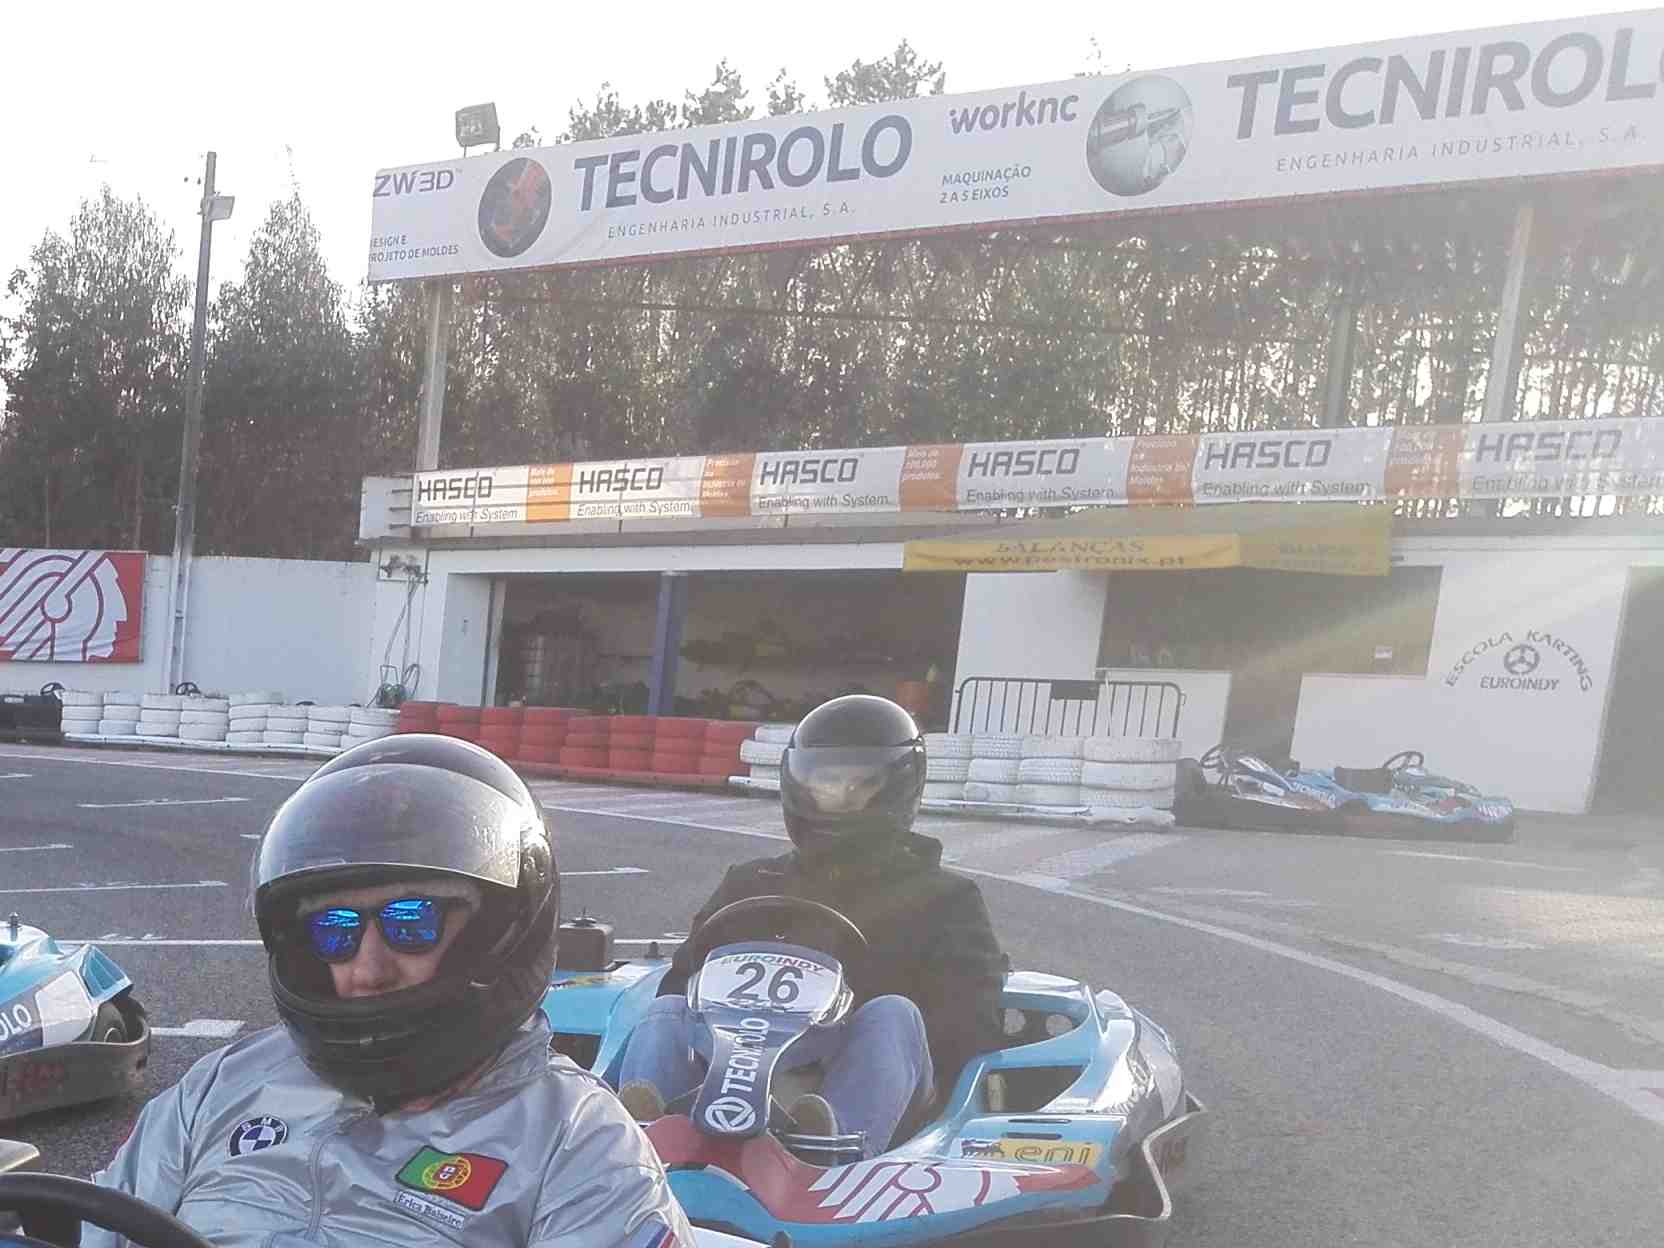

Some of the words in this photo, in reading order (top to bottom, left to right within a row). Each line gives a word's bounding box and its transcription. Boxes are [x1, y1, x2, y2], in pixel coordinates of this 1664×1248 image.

[1227, 27, 1664, 140] TECNIROL
[949, 91, 1079, 134] worknc
[574, 115, 913, 211] TECNIROLO
[1277, 145, 1419, 173] ENGENHARIA
[373, 170, 454, 197] ZW3D
[942, 164, 1032, 187] MAQUINAÇÃO
[950, 192, 959, 203] A
[972, 186, 1009, 201] EIXOS
[608, 217, 706, 239] ENGENHARIA
[422, 245, 459, 257] MOLDES
[1204, 440, 1332, 470] HASCO
[1475, 429, 1623, 462] HASCO
[760, 458, 859, 485] HASCO
[968, 449, 1081, 477] HASCO
[418, 475, 492, 501] HASCO
[579, 466, 664, 493] HASCO
[1203, 480, 1269, 497] Enabling
[758, 496, 810, 511] Enabling
[813, 496, 838, 508] with
[1446, 631, 1513, 687] ESCOLA
[1526, 630, 1593, 691] KARTING
[1480, 677, 1559, 690] EUROINDY
[726, 962, 804, 1003] 26
